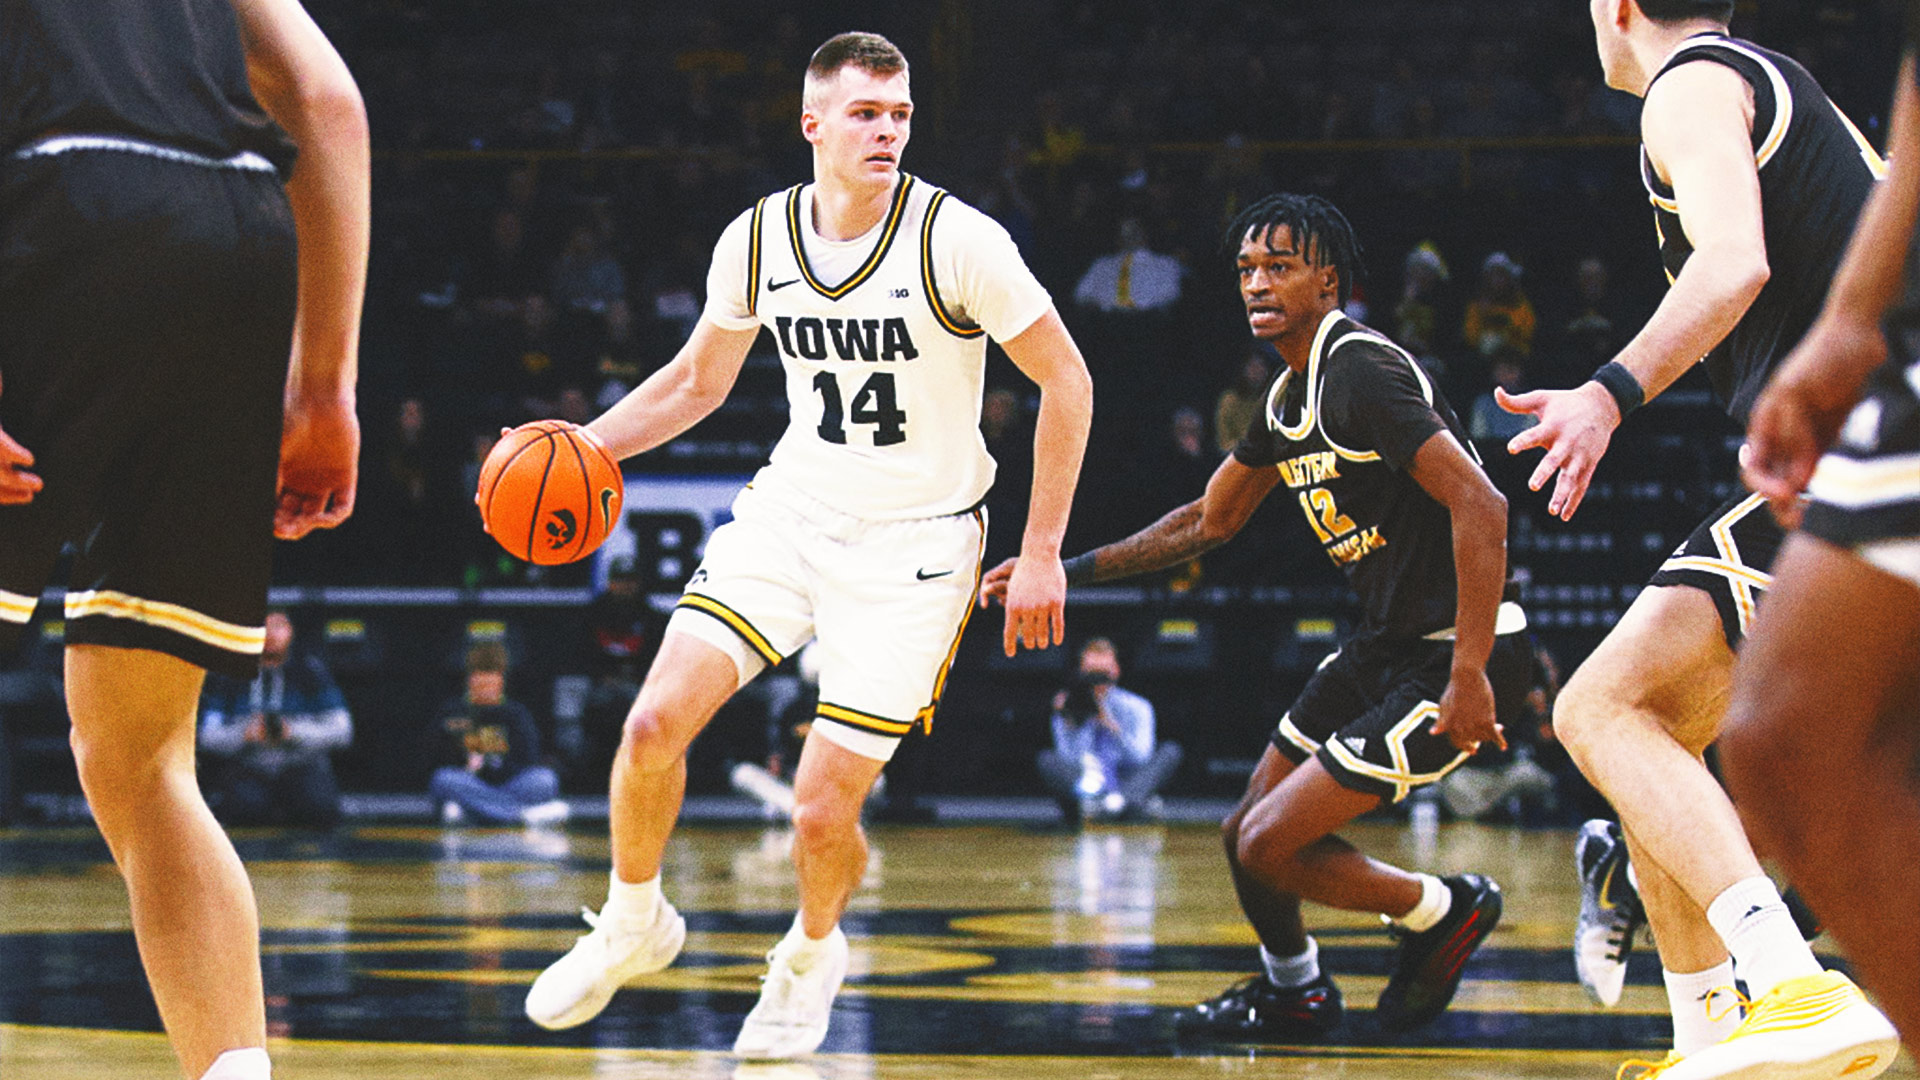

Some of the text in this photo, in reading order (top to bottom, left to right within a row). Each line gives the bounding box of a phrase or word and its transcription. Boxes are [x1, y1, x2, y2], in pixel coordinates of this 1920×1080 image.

[775, 316, 919, 362] IOWA
[812, 370, 907, 446] 14
[1299, 487, 1357, 544] 12
